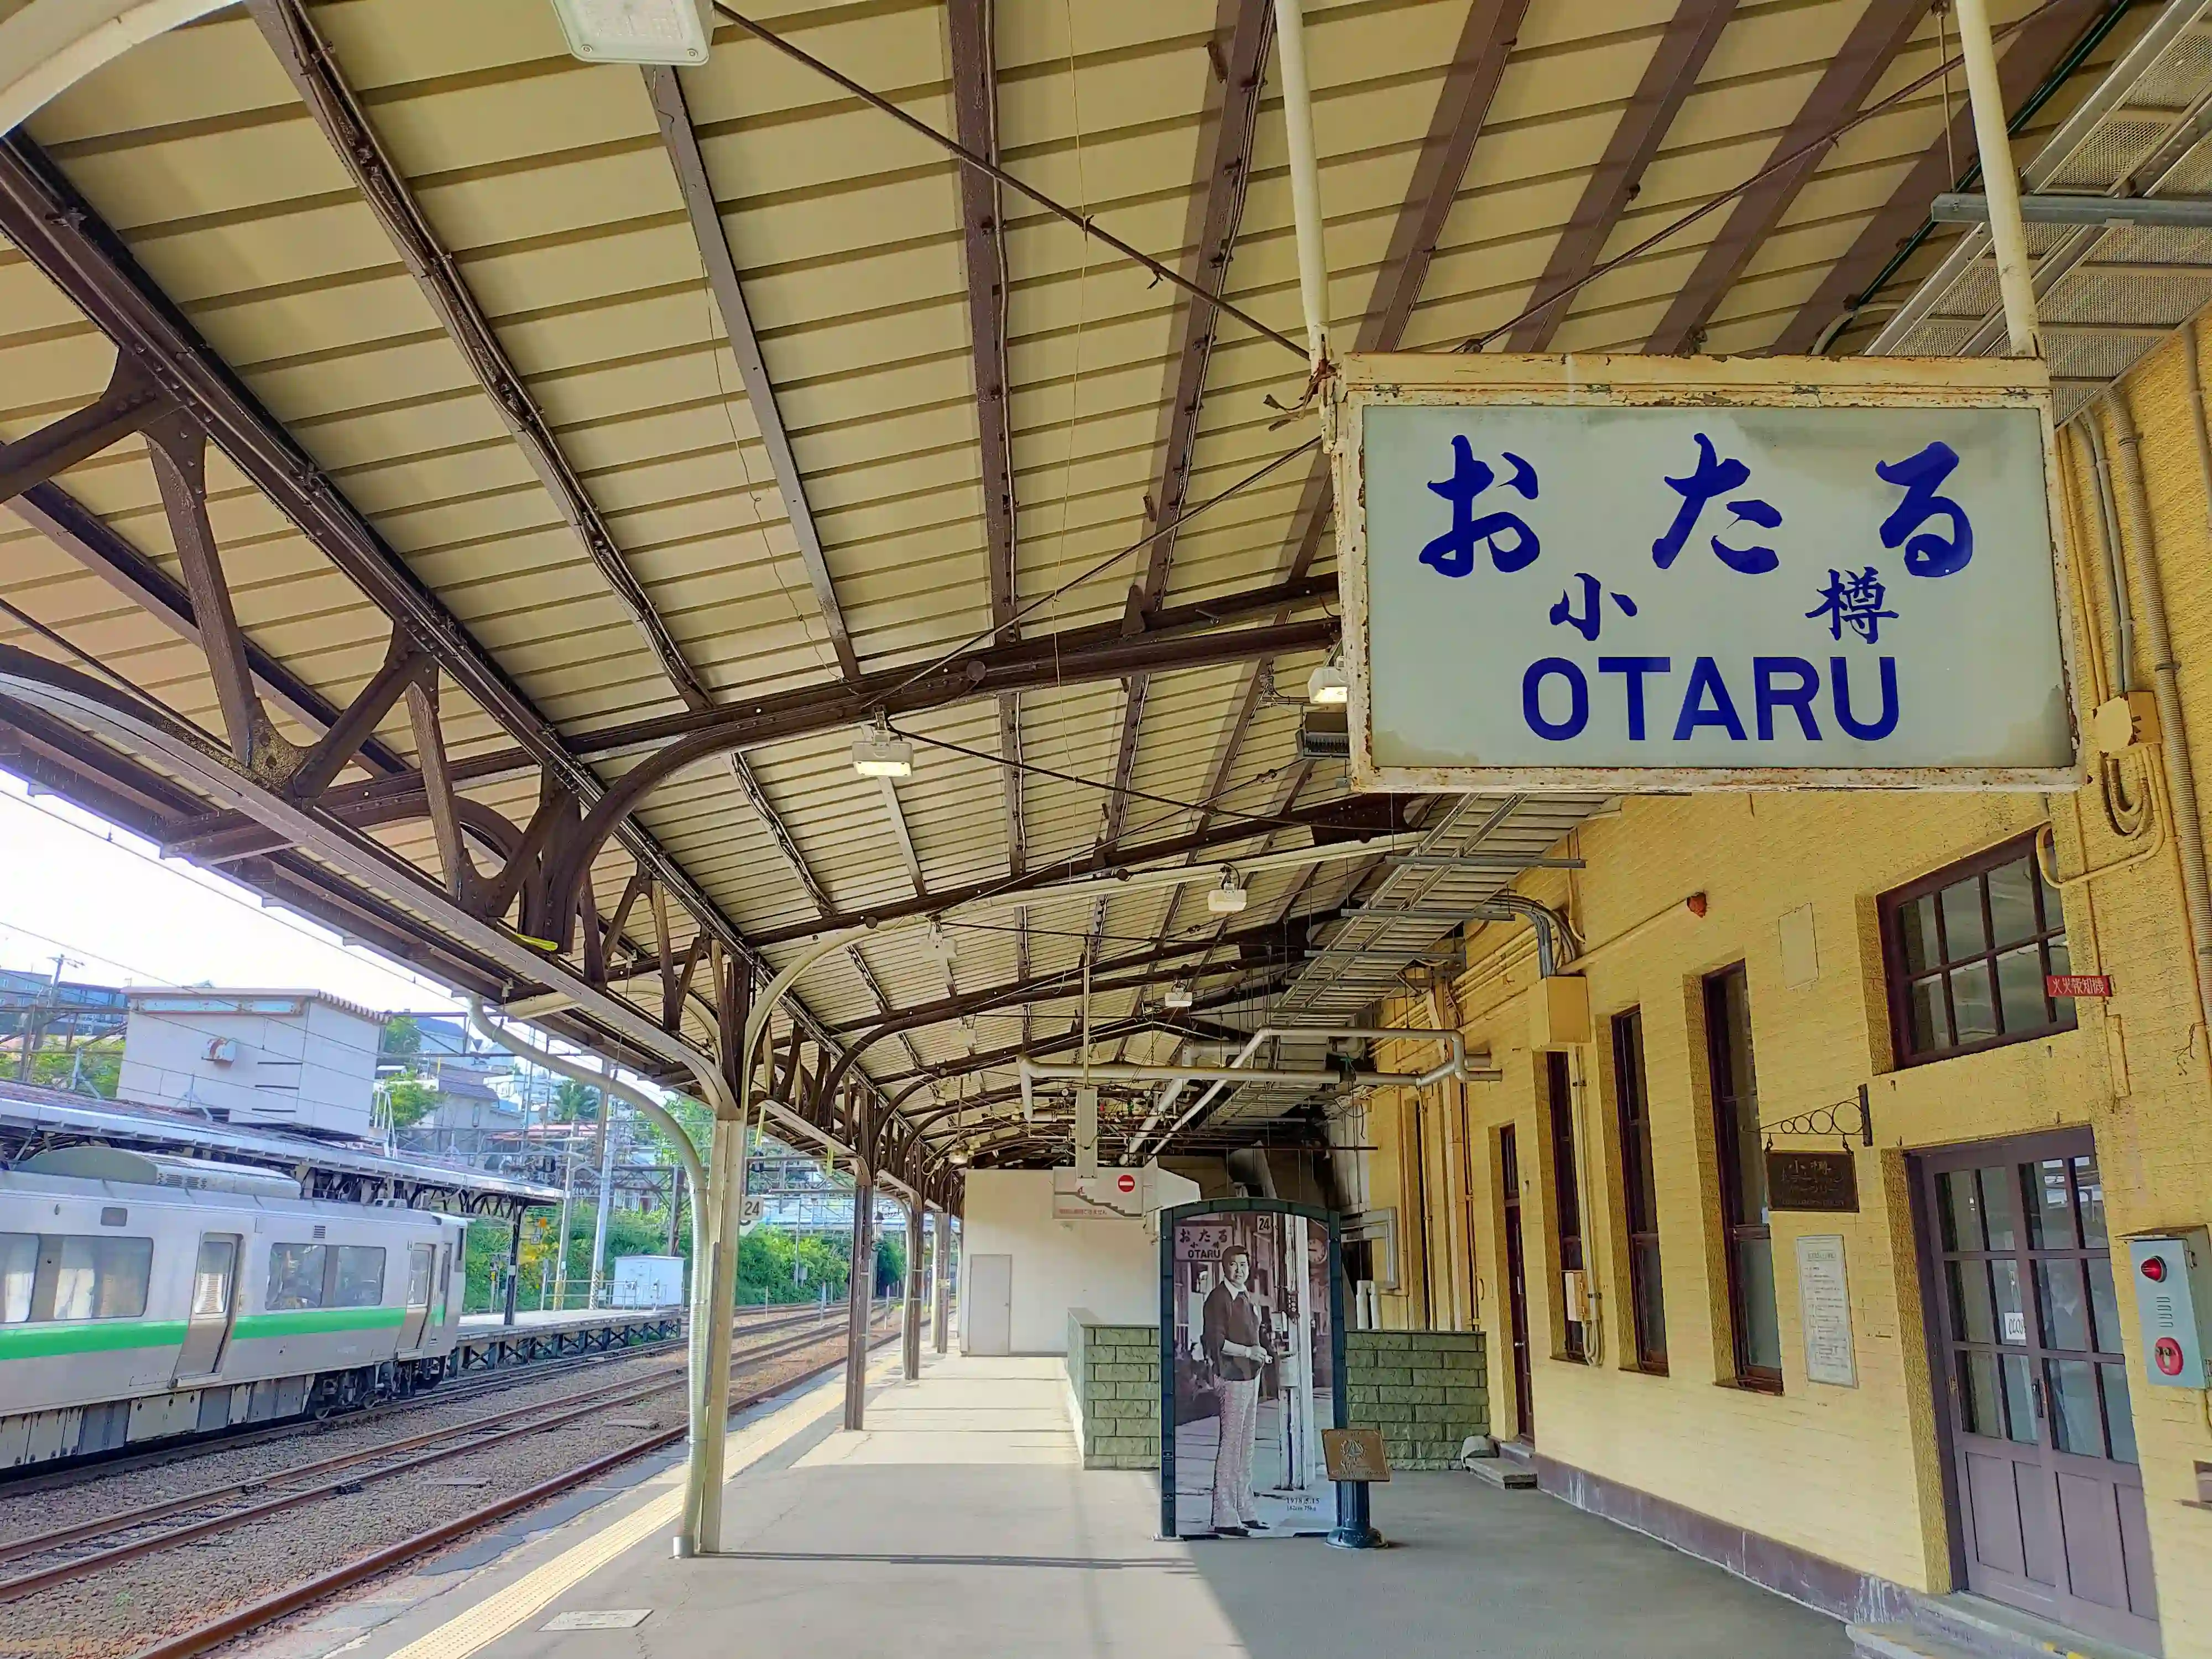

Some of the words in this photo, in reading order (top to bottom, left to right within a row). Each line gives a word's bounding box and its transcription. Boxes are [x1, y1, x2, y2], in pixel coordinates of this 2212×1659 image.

[1418, 433, 1973, 578] おたる
[1549, 566, 1900, 644] 小樽
[1522, 656, 1900, 742] OTARU
[744, 1201, 760, 1216] 24
[1259, 1218, 1270, 1230] 24
[1188, 1250, 1220, 1258] OTARU
